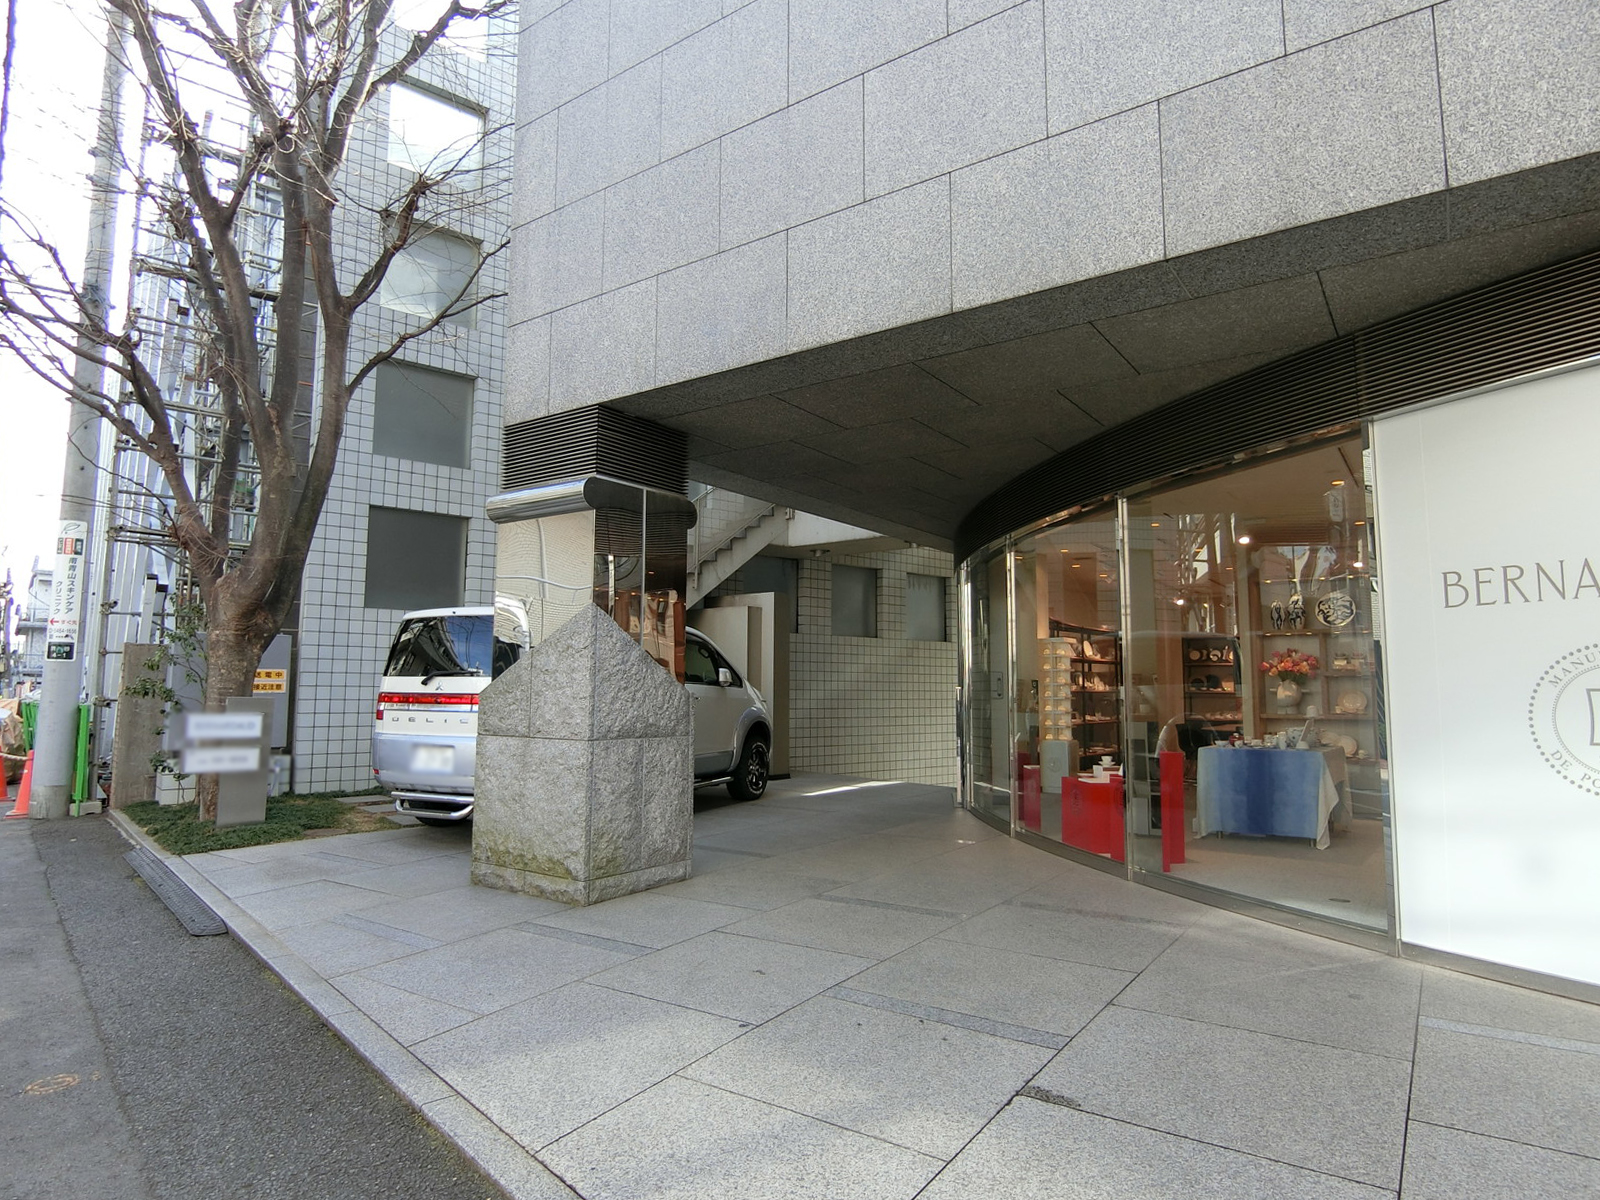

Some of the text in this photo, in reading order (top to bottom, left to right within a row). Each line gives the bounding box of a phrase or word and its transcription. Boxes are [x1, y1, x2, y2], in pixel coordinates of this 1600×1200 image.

[53, 581, 63, 614] クリニック
[65, 557, 78, 614] 南青山スキンケア
[1441, 557, 1600, 608] BERNA
[1550, 749, 1572, 771] DE
